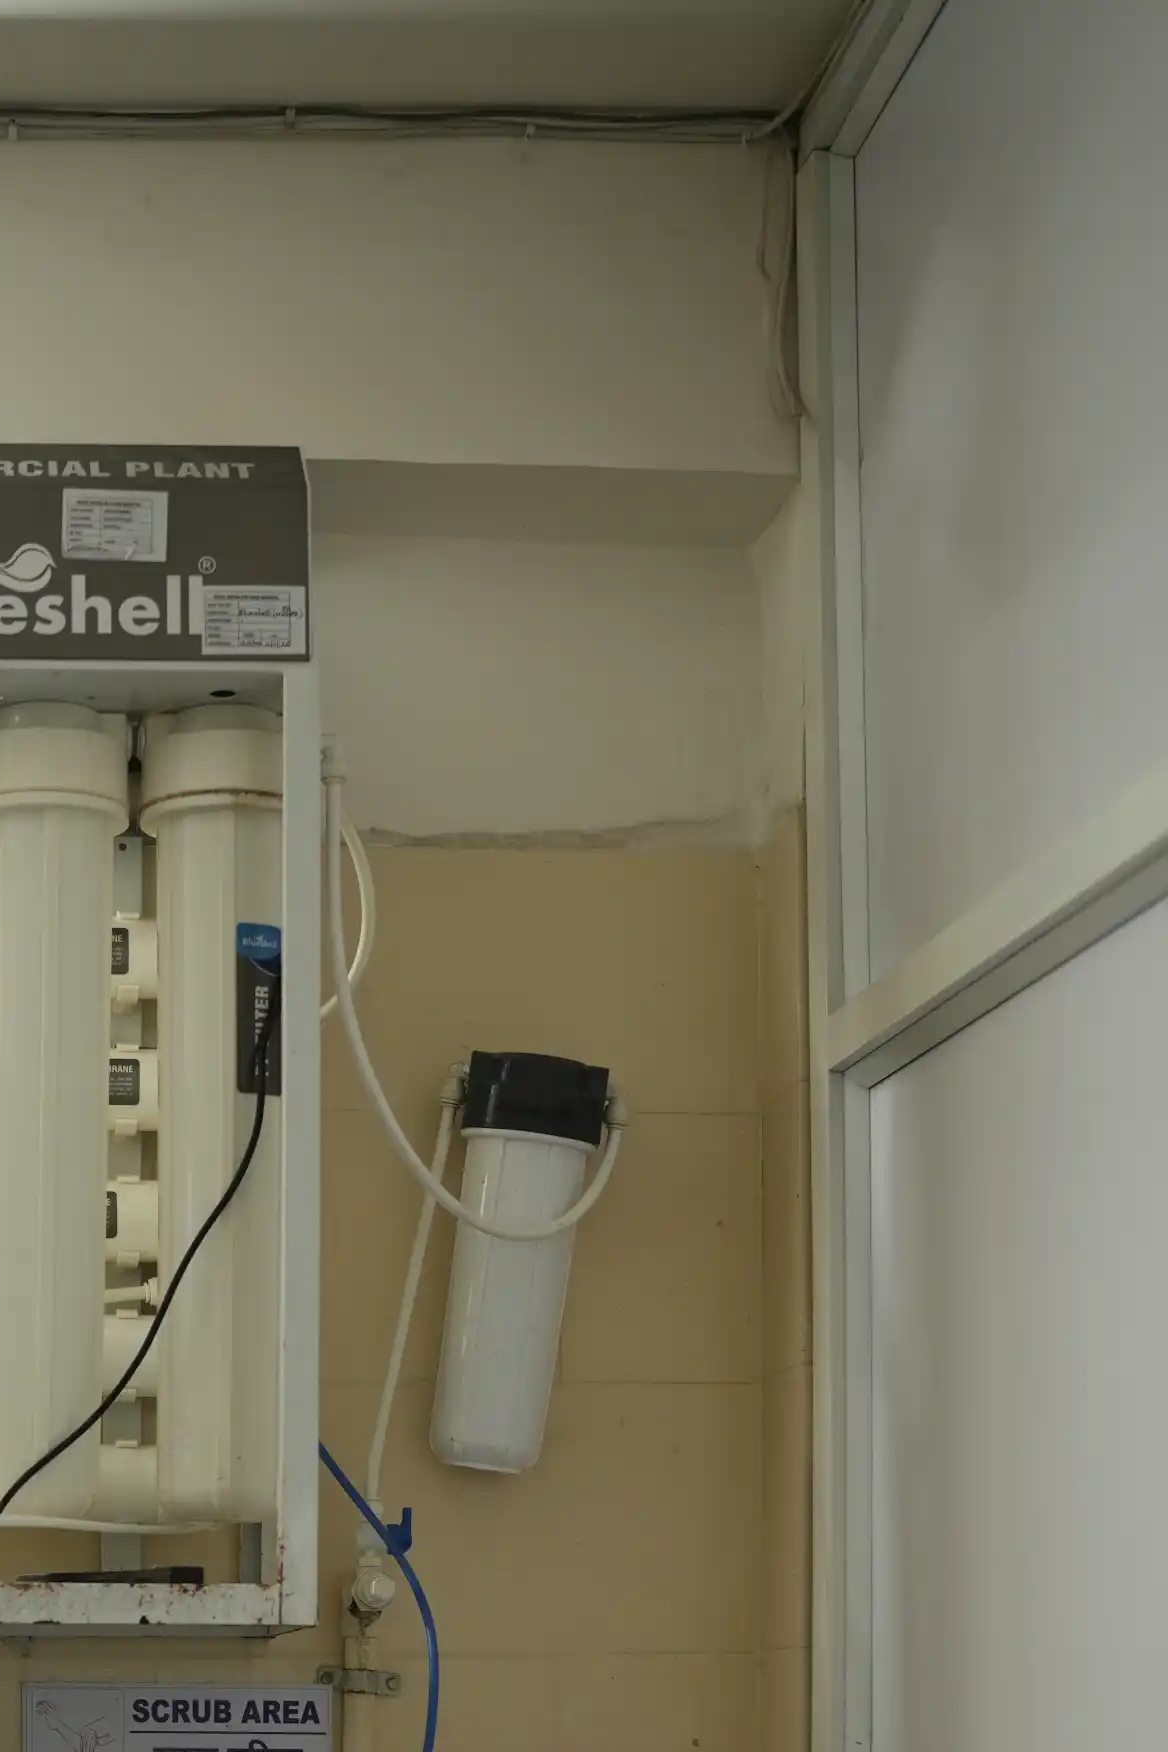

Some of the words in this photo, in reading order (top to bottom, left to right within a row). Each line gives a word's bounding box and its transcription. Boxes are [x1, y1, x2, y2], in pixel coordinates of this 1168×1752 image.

[125, 461, 254, 480] PLANT
[132, 1699, 231, 1723] SCRUB
[241, 1700, 320, 1724] AREA
